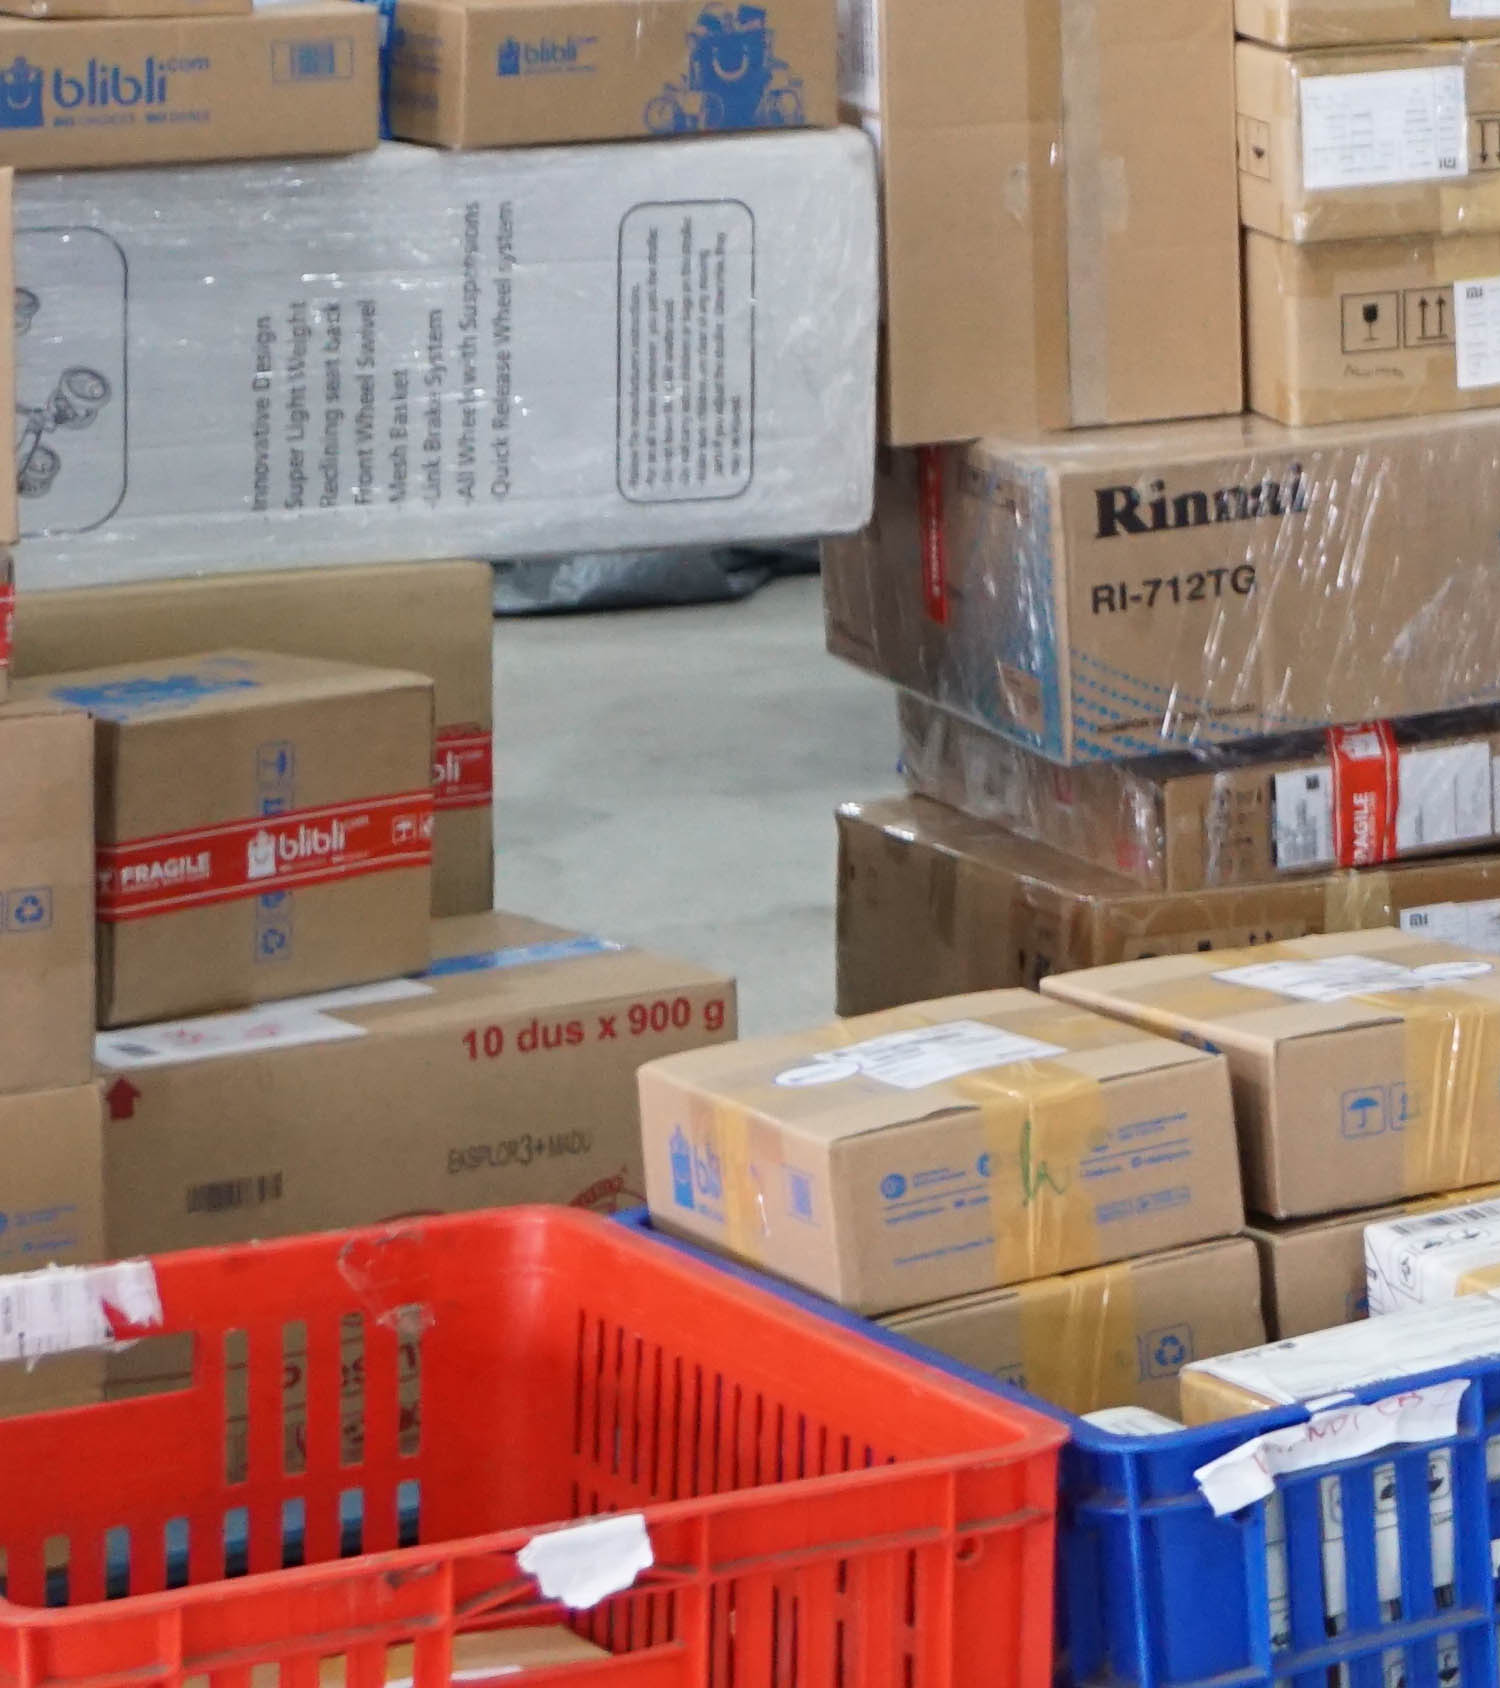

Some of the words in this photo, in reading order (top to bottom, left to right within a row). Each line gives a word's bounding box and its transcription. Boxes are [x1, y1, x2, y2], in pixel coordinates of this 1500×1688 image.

[53, 56, 210, 109] blibli.com
[287, 301, 312, 381] Weight
[356, 299, 376, 369] Swivel
[494, 278, 513, 344] Wheel
[286, 385, 310, 443] Light
[323, 358, 341, 404] seat
[355, 374, 375, 443] Wheel
[492, 349, 512, 431] Release
[251, 397, 271, 511] Innovative
[284, 447, 307, 510] Super
[318, 408, 344, 508] Reclining
[1094, 461, 1308, 539] Rinnai
[1090, 564, 1257, 614] RI-712TG
[120, 851, 212, 888] FRAGILE
[462, 1024, 505, 1061] 10
[516, 1016, 585, 1054] dus
[597, 1014, 618, 1041] x
[627, 996, 692, 1036] 900
[702, 996, 726, 1032] g
